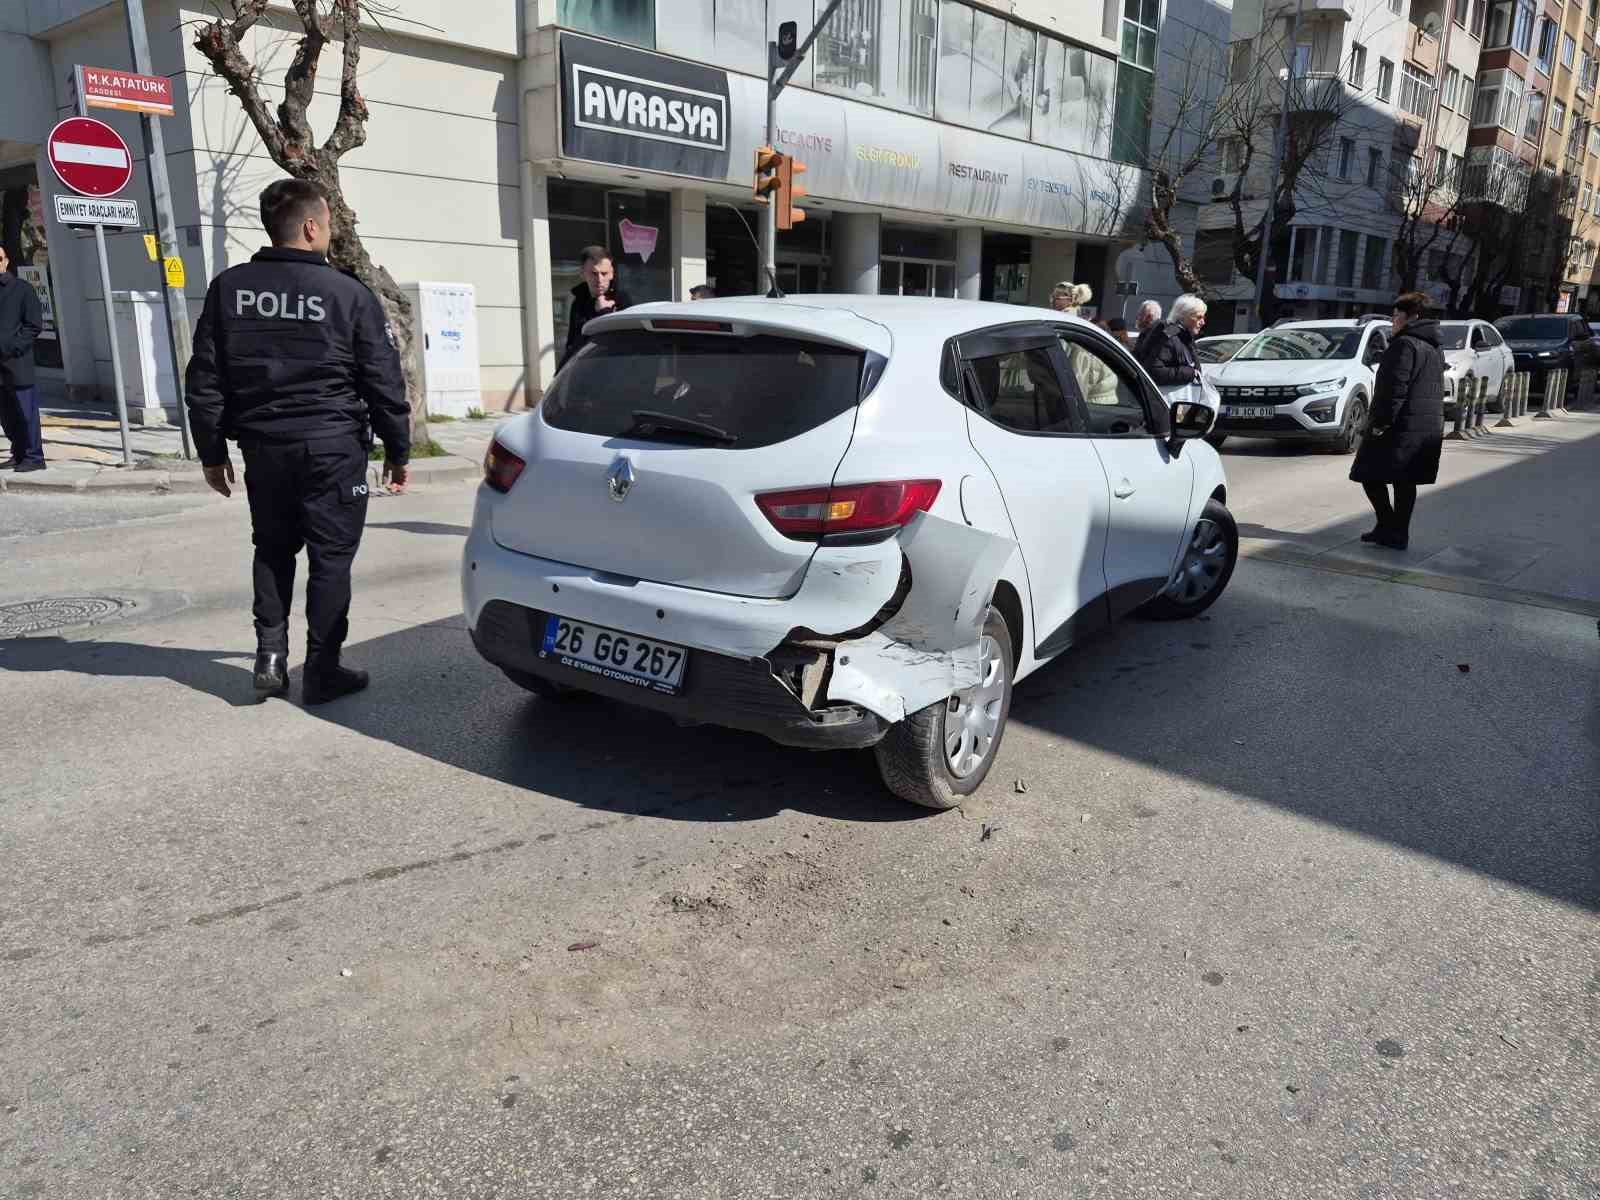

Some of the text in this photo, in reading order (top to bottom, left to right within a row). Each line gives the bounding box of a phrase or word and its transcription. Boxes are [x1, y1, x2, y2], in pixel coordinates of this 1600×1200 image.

[584, 82, 718, 140] AVRASYA
[948, 162, 1009, 186] RESTAURANT
[235, 289, 326, 321] POLİS
[555, 622, 682, 679] 26 GG 267
